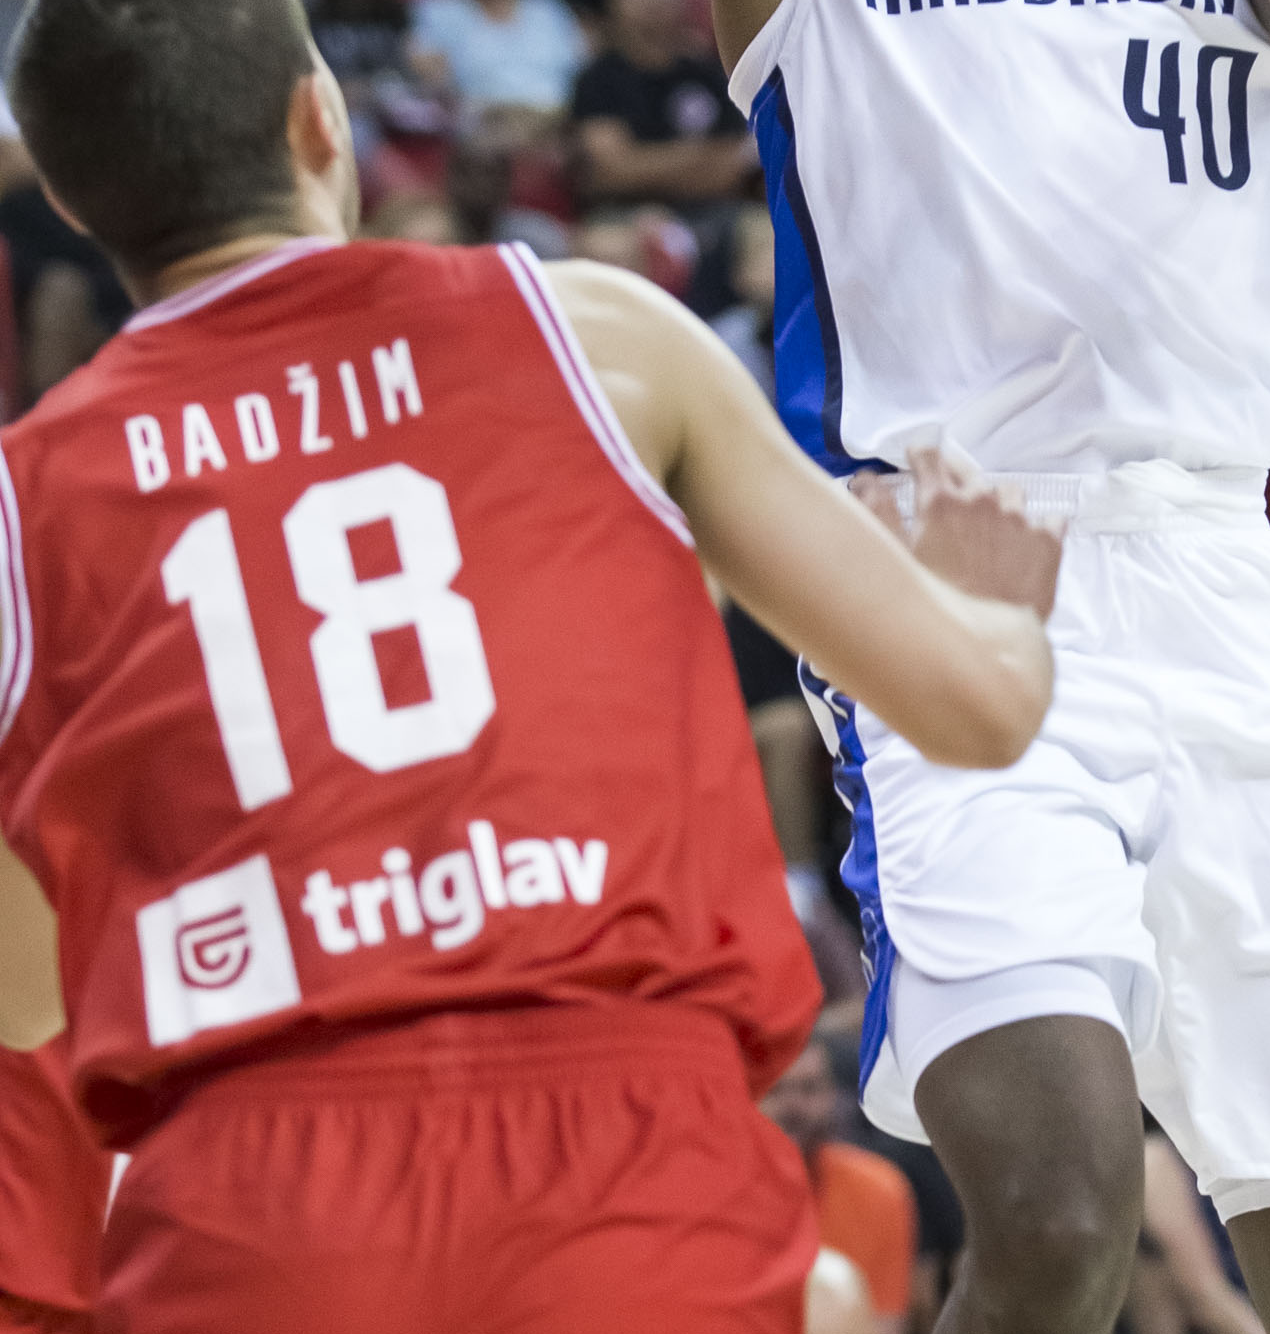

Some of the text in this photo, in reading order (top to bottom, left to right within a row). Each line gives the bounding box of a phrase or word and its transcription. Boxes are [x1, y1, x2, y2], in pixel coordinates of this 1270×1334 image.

[1123, 38, 1258, 192] 40
[125, 337, 423, 494] BADŽIM
[161, 462, 497, 812] 18
[303, 820, 607, 952] triglav
